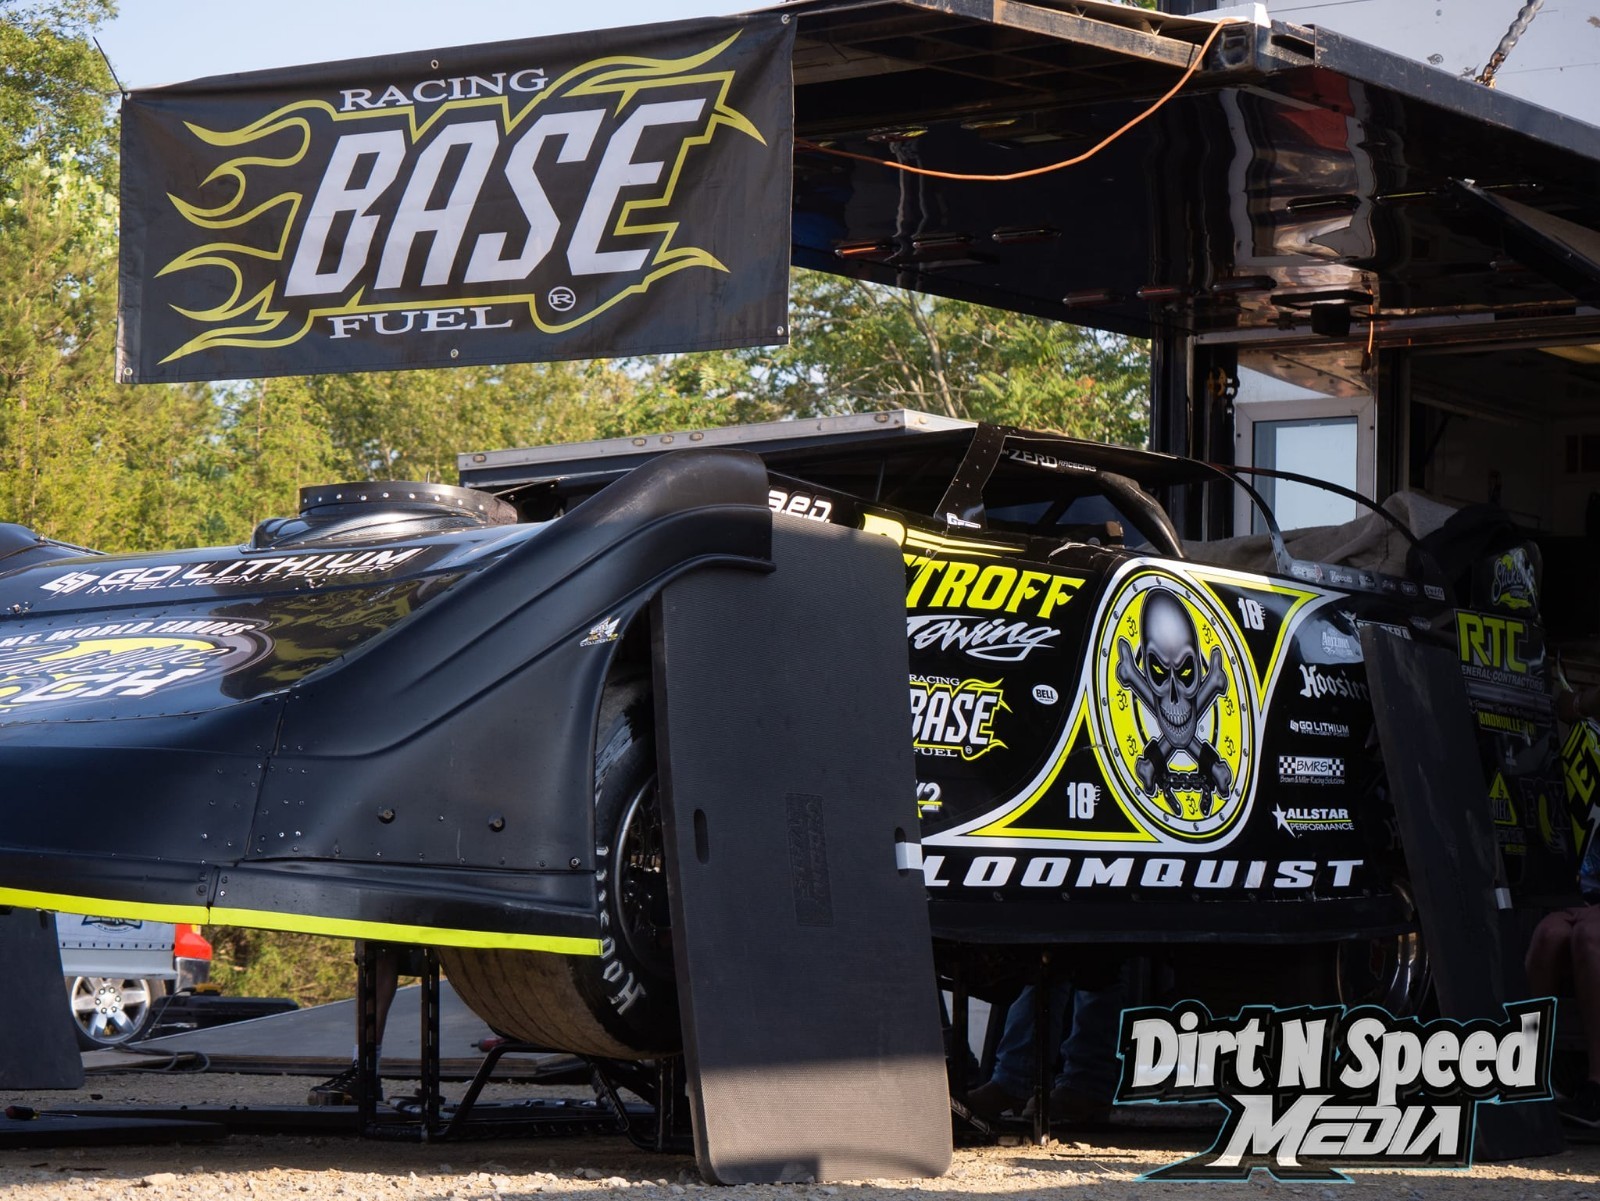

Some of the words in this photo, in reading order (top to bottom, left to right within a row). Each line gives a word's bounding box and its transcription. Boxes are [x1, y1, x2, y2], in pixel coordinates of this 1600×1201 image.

[340, 68, 549, 112] RACING
[284, 98, 707, 298] BASE
[328, 306, 514, 340] FUEL
[86, 573, 280, 595] INTELLIGENT
[281, 563, 398, 581] POWER
[98, 565, 181, 586] GO
[182, 547, 426, 580] LITHIUM
[903, 553, 1087, 619] TROFF
[1238, 597, 1265, 631] 18
[0, 633, 43, 648] HE
[45, 622, 154, 642] WORLD
[149, 618, 256, 637] FAMOUS
[1457, 612, 1527, 674] RTC
[909, 673, 960, 687] RACING
[1036, 688, 1054, 700] BELL
[1299, 663, 1369, 700] Hoosier
[1461, 664, 1491, 680] ENERAL
[1492, 671, 1545, 692] CONTRACTORS
[909, 688, 998, 745] BASE
[1300, 721, 1313, 730] GO
[1315, 722, 1349, 734] LITHIUM
[1297, 761, 1328, 773] BMRS
[1068, 782, 1095, 819] 18
[1286, 808, 1349, 820] ALLSTAR
[1290, 822, 1355, 831] PERFORMANCE
[923, 855, 1364, 889] LOOMQUIST
